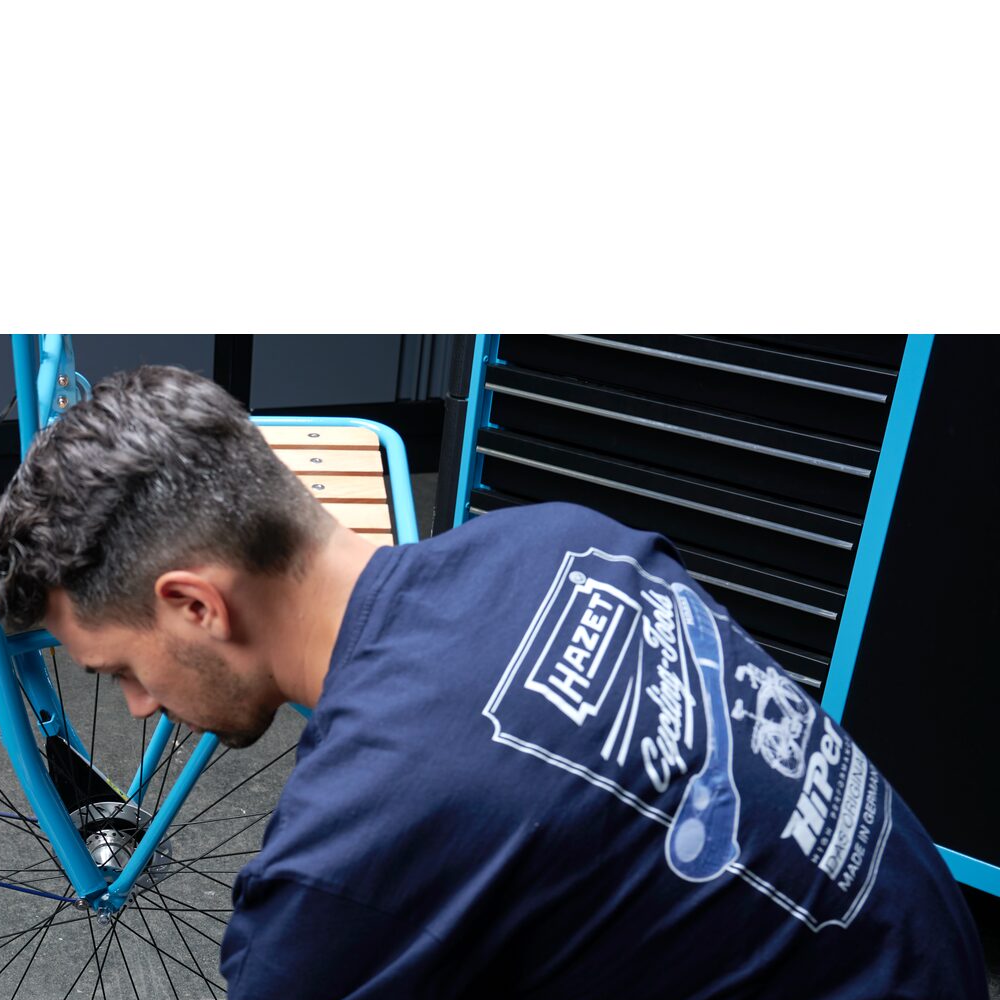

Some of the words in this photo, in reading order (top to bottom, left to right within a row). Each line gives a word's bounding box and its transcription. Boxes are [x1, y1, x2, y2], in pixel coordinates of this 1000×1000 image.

[546, 590, 624, 705] HAZET
[780, 716, 843, 857] HiPer
[824, 830, 848, 875] DAS
[842, 755, 866, 831] ORIGINA
[837, 840, 867, 892] MADE
[858, 823, 872, 844] IN
